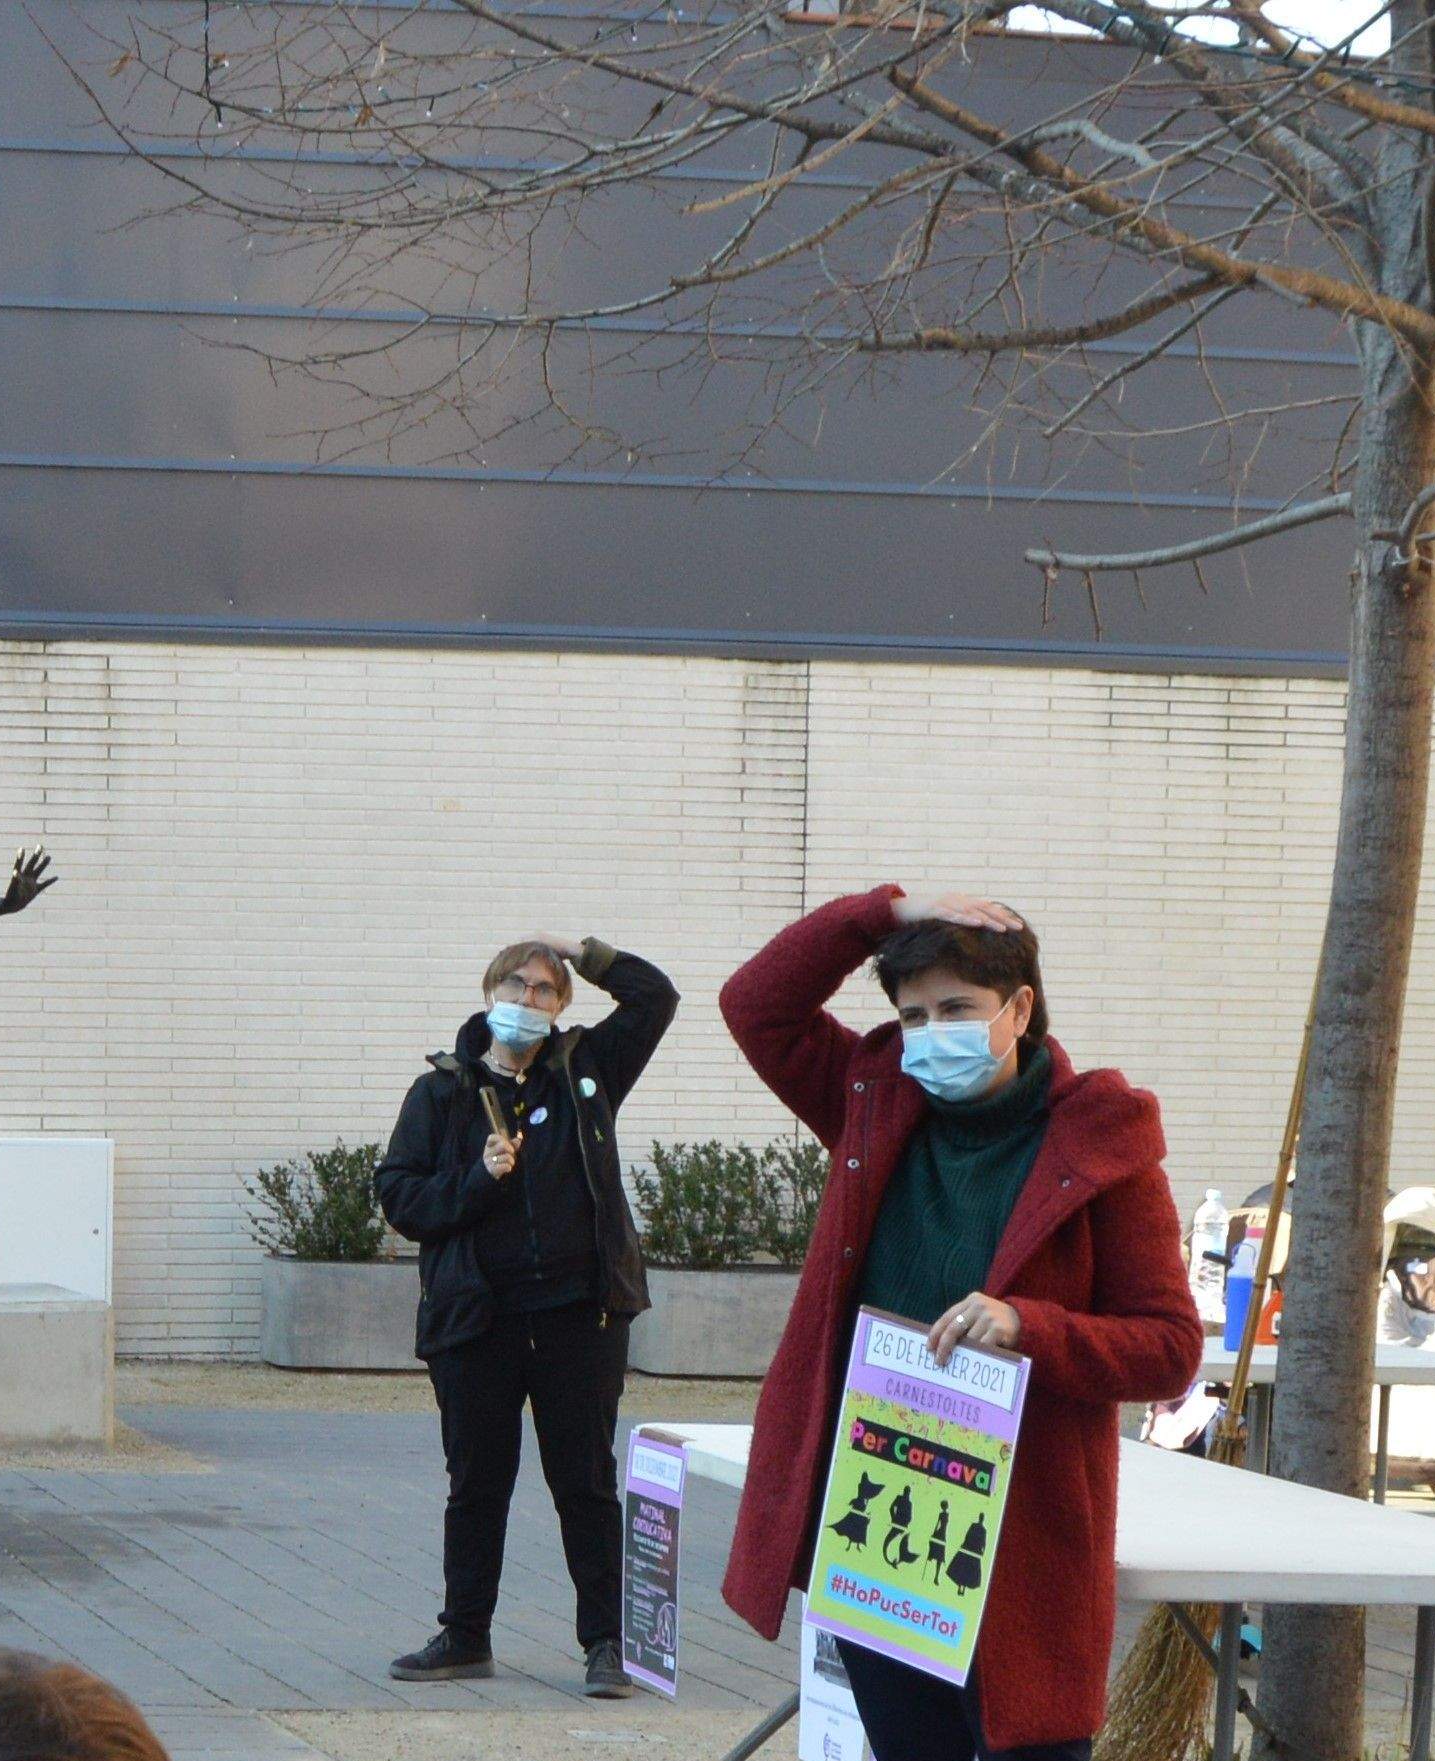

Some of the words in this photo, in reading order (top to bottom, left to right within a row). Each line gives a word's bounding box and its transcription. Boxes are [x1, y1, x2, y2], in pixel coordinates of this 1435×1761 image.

[873, 1330, 895, 1358] 26
[896, 1336, 915, 1365] DE
[971, 1361, 1006, 1393] 2021
[885, 1377, 982, 1422] CARNESTOLTES
[850, 1419, 888, 1453] Per
[831, 1573, 959, 1638] #HoPucSerTot
